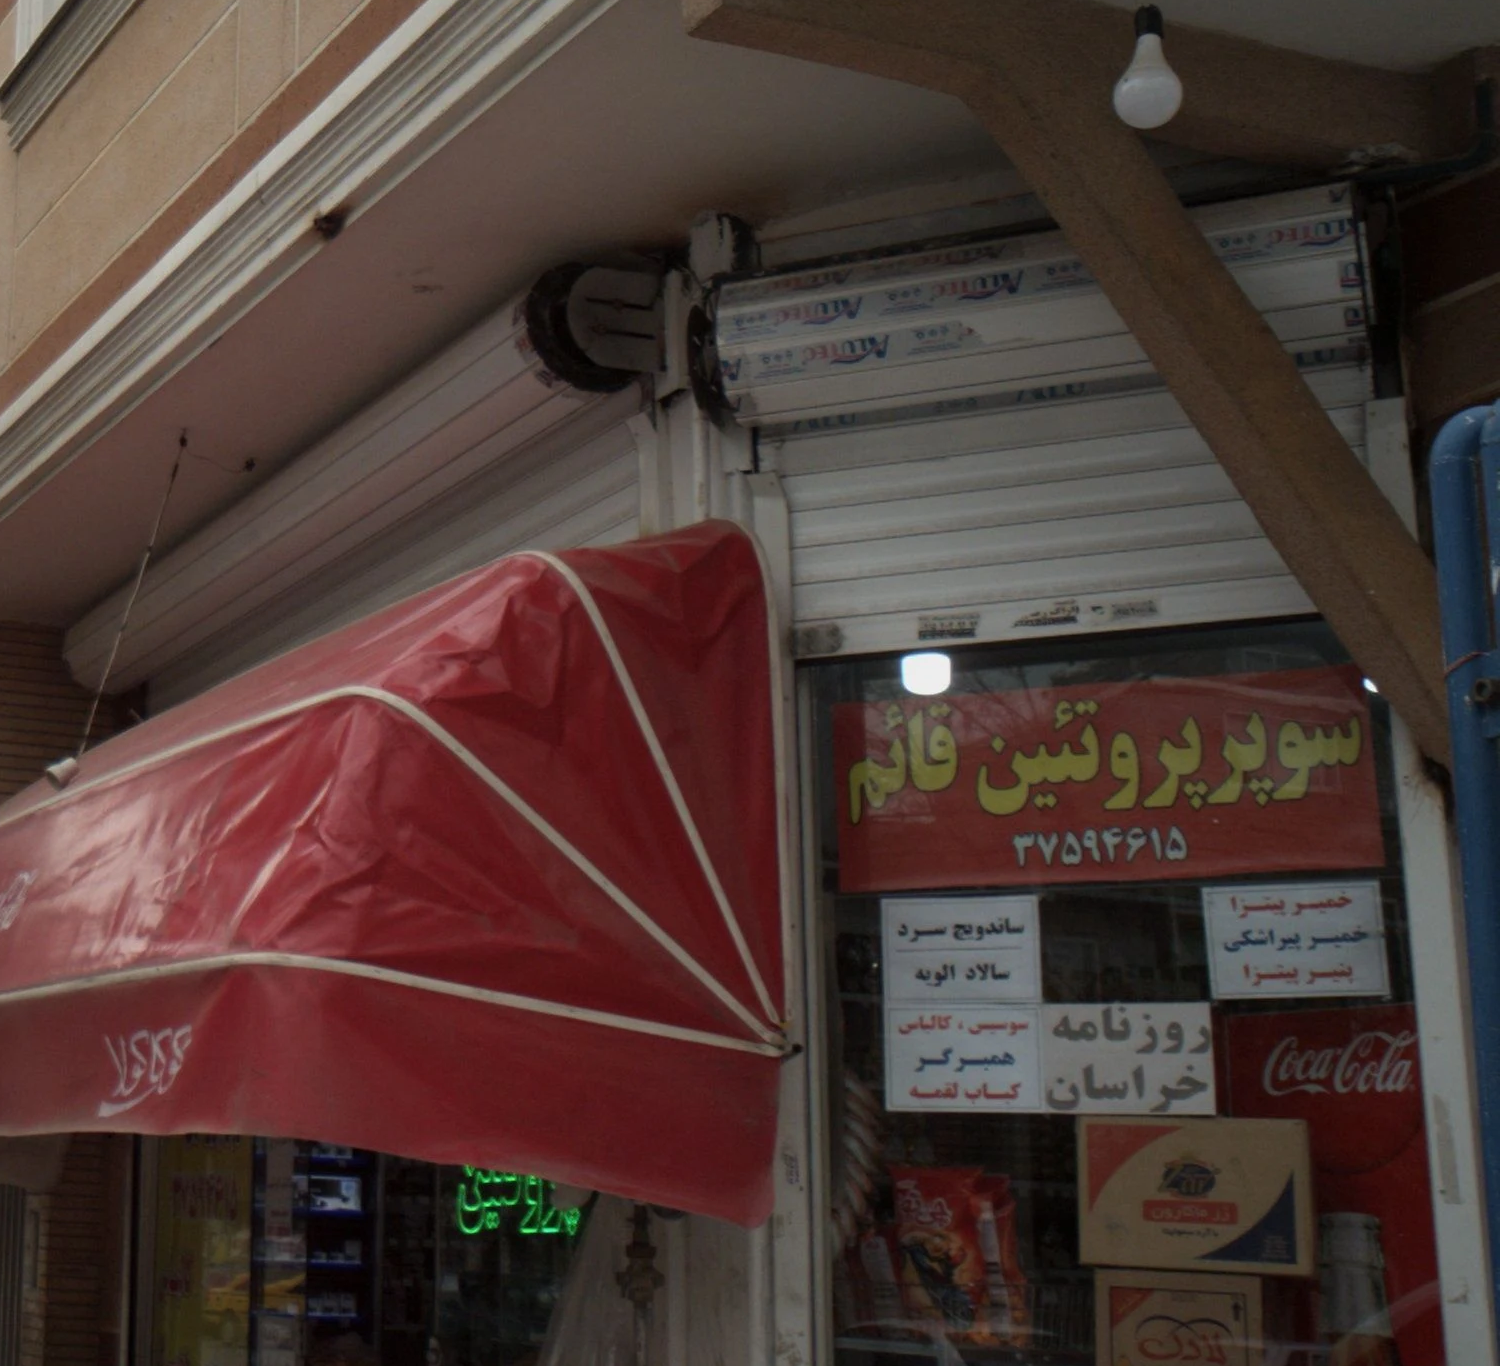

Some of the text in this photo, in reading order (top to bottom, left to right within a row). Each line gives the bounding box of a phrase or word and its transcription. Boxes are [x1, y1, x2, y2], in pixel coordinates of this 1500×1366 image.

[932, 269, 1024, 301] ALUTEC
[803, 334, 890, 365] ALUTEC
[847, 699, 1363, 825] سوپر پروتئین قائم
[1011, 824, 1190, 868] ۳۷۵۹۴۶۱۵
[1230, 891, 1353, 919] خمیر پیتزا
[898, 917, 1025, 943] ساندویچ سرد
[1223, 925, 1368, 953] خمیر پیراشکی
[914, 963, 1011, 987] سالاد الویه
[1243, 964, 1300, 987] پیتزا
[898, 1014, 953, 1035] کالباس
[1051, 1005, 1211, 1054] روزنامه
[1261, 1030, 1419, 1097] Coca-Cola
[908, 1082, 1023, 1105] کباب لقمه
[1045, 1063, 1209, 1112] خراسان
